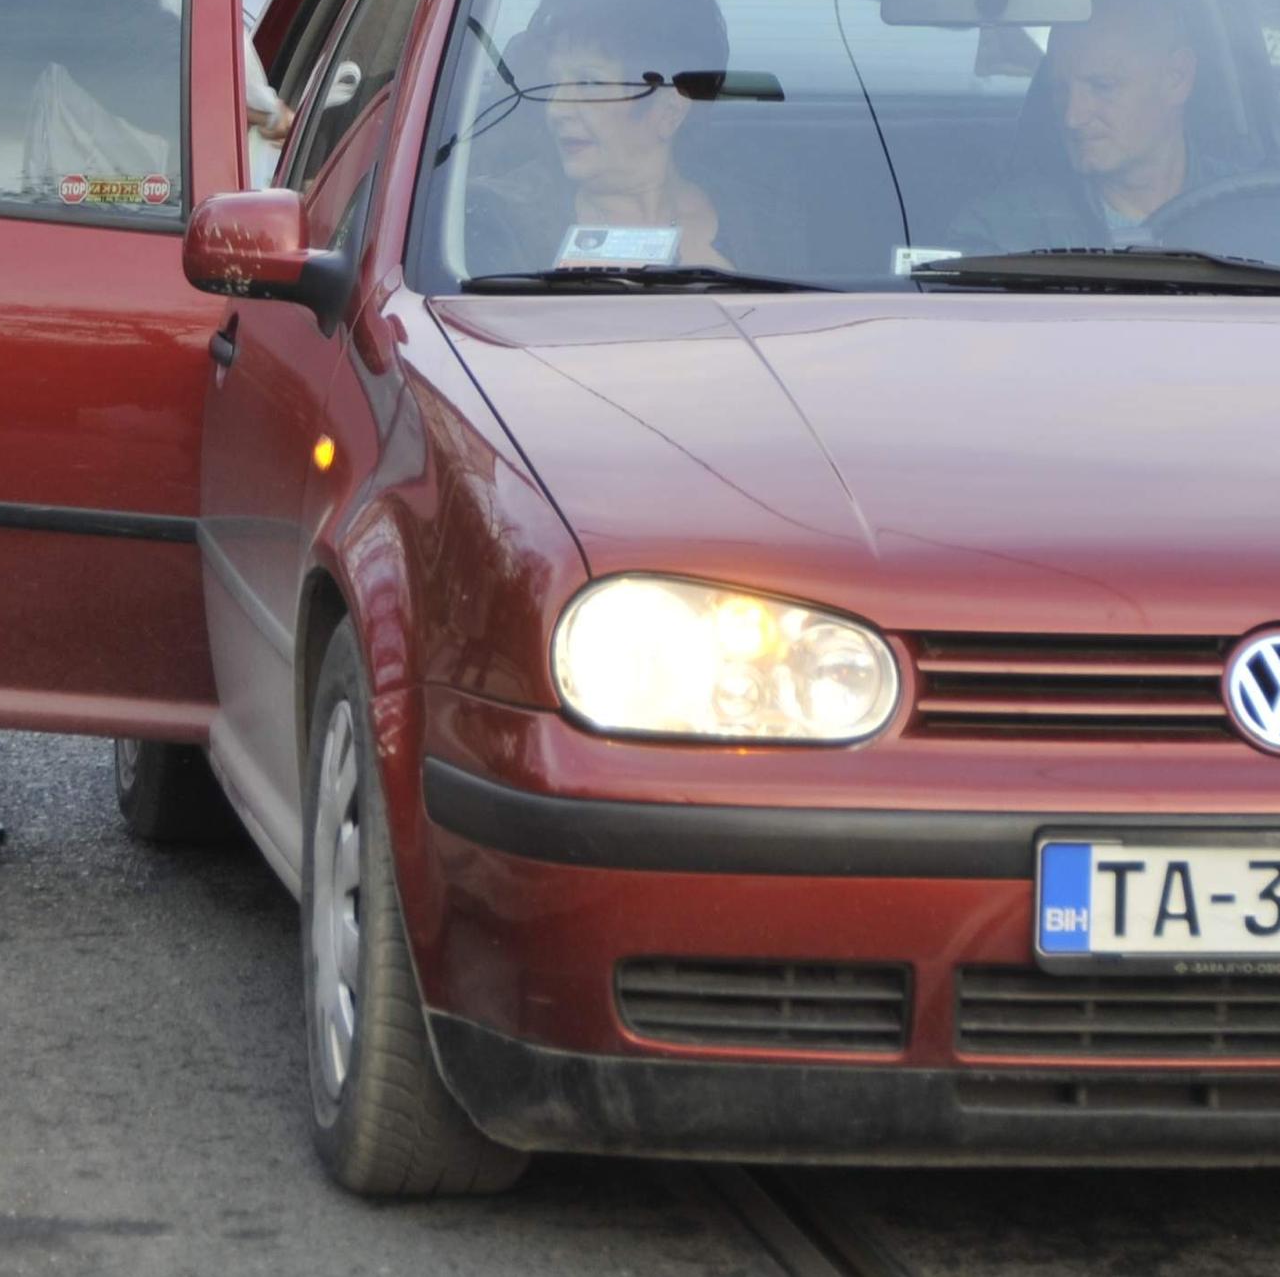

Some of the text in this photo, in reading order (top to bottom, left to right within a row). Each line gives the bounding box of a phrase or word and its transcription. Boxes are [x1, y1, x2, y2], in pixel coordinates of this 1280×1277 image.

[61, 182, 86, 195] STOP
[143, 183, 168, 196] STOP
[1045, 906, 1089, 933] BIH
